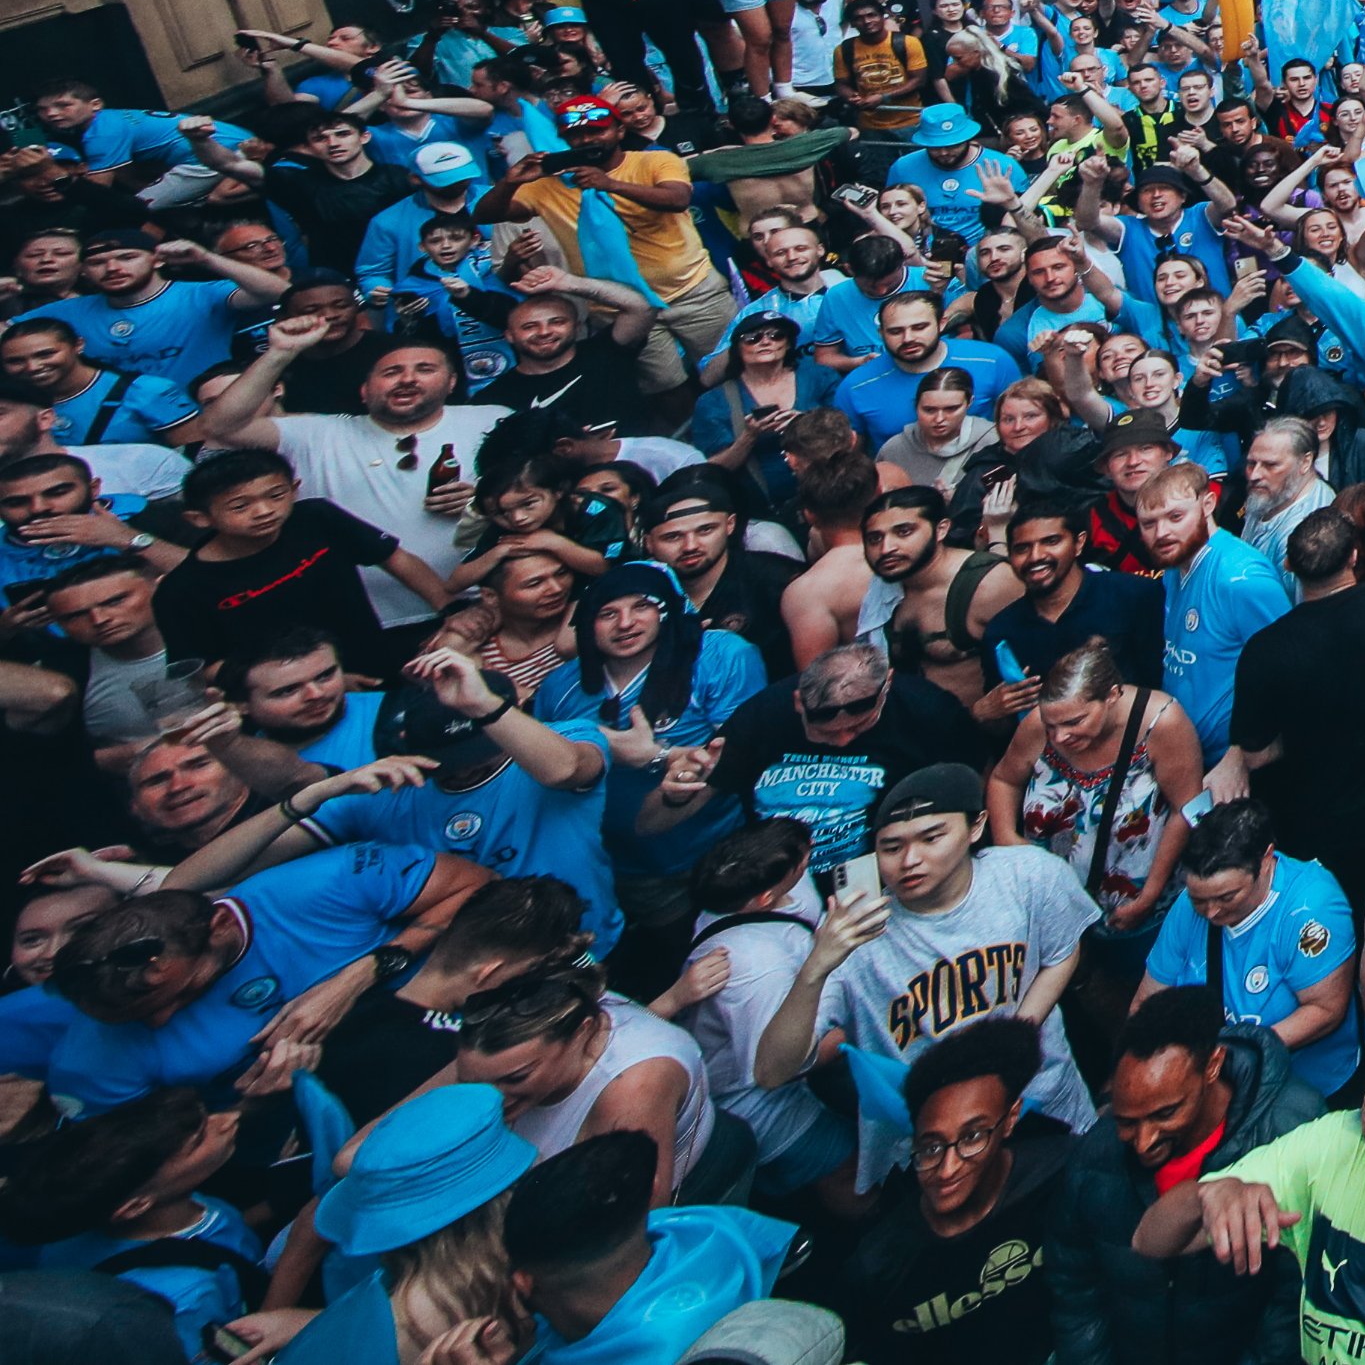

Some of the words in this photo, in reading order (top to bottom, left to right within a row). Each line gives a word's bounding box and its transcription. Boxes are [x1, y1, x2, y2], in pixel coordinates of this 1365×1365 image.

[755, 762, 886, 791] MANCHESTER
[797, 781, 842, 798] CITY
[889, 942, 1029, 1052] SPORTS
